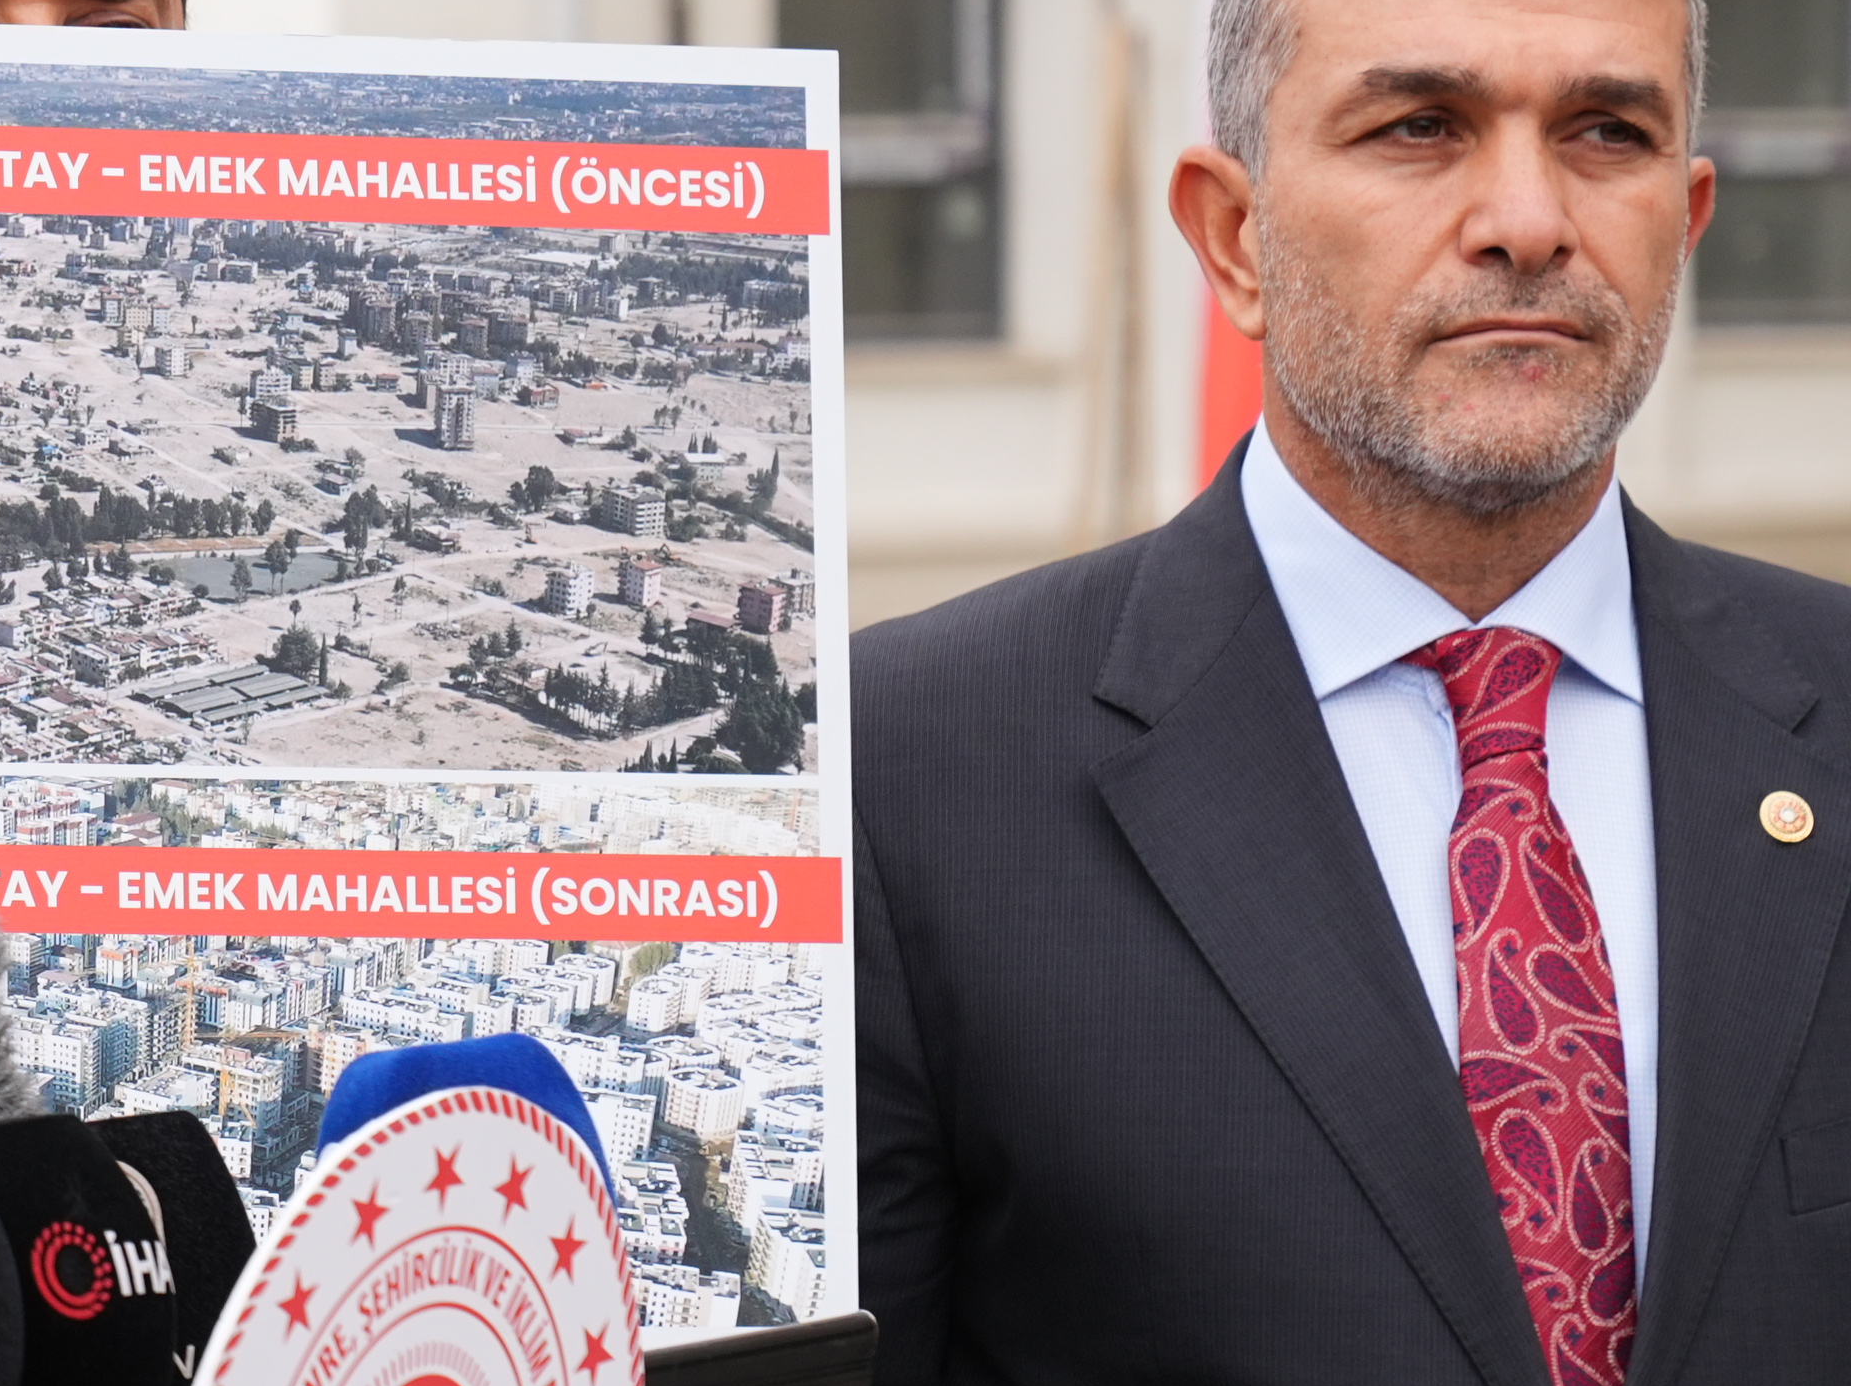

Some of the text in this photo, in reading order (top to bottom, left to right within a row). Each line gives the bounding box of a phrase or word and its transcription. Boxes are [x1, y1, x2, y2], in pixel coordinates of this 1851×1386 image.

[140, 154, 266, 196] EMEK
[278, 157, 537, 204] MAHALLESİ
[551, 155, 766, 219] (ÖNCESİ)
[117, 870, 246, 911] EMEK
[257, 867, 517, 915] MAHALLESİ
[531, 867, 779, 928] (SONRASI)
[358, 1237, 485, 1341] ŞEHİRCİLİK
[482, 1256, 512, 1309] VE
[503, 1275, 552, 1383] İKLİM
